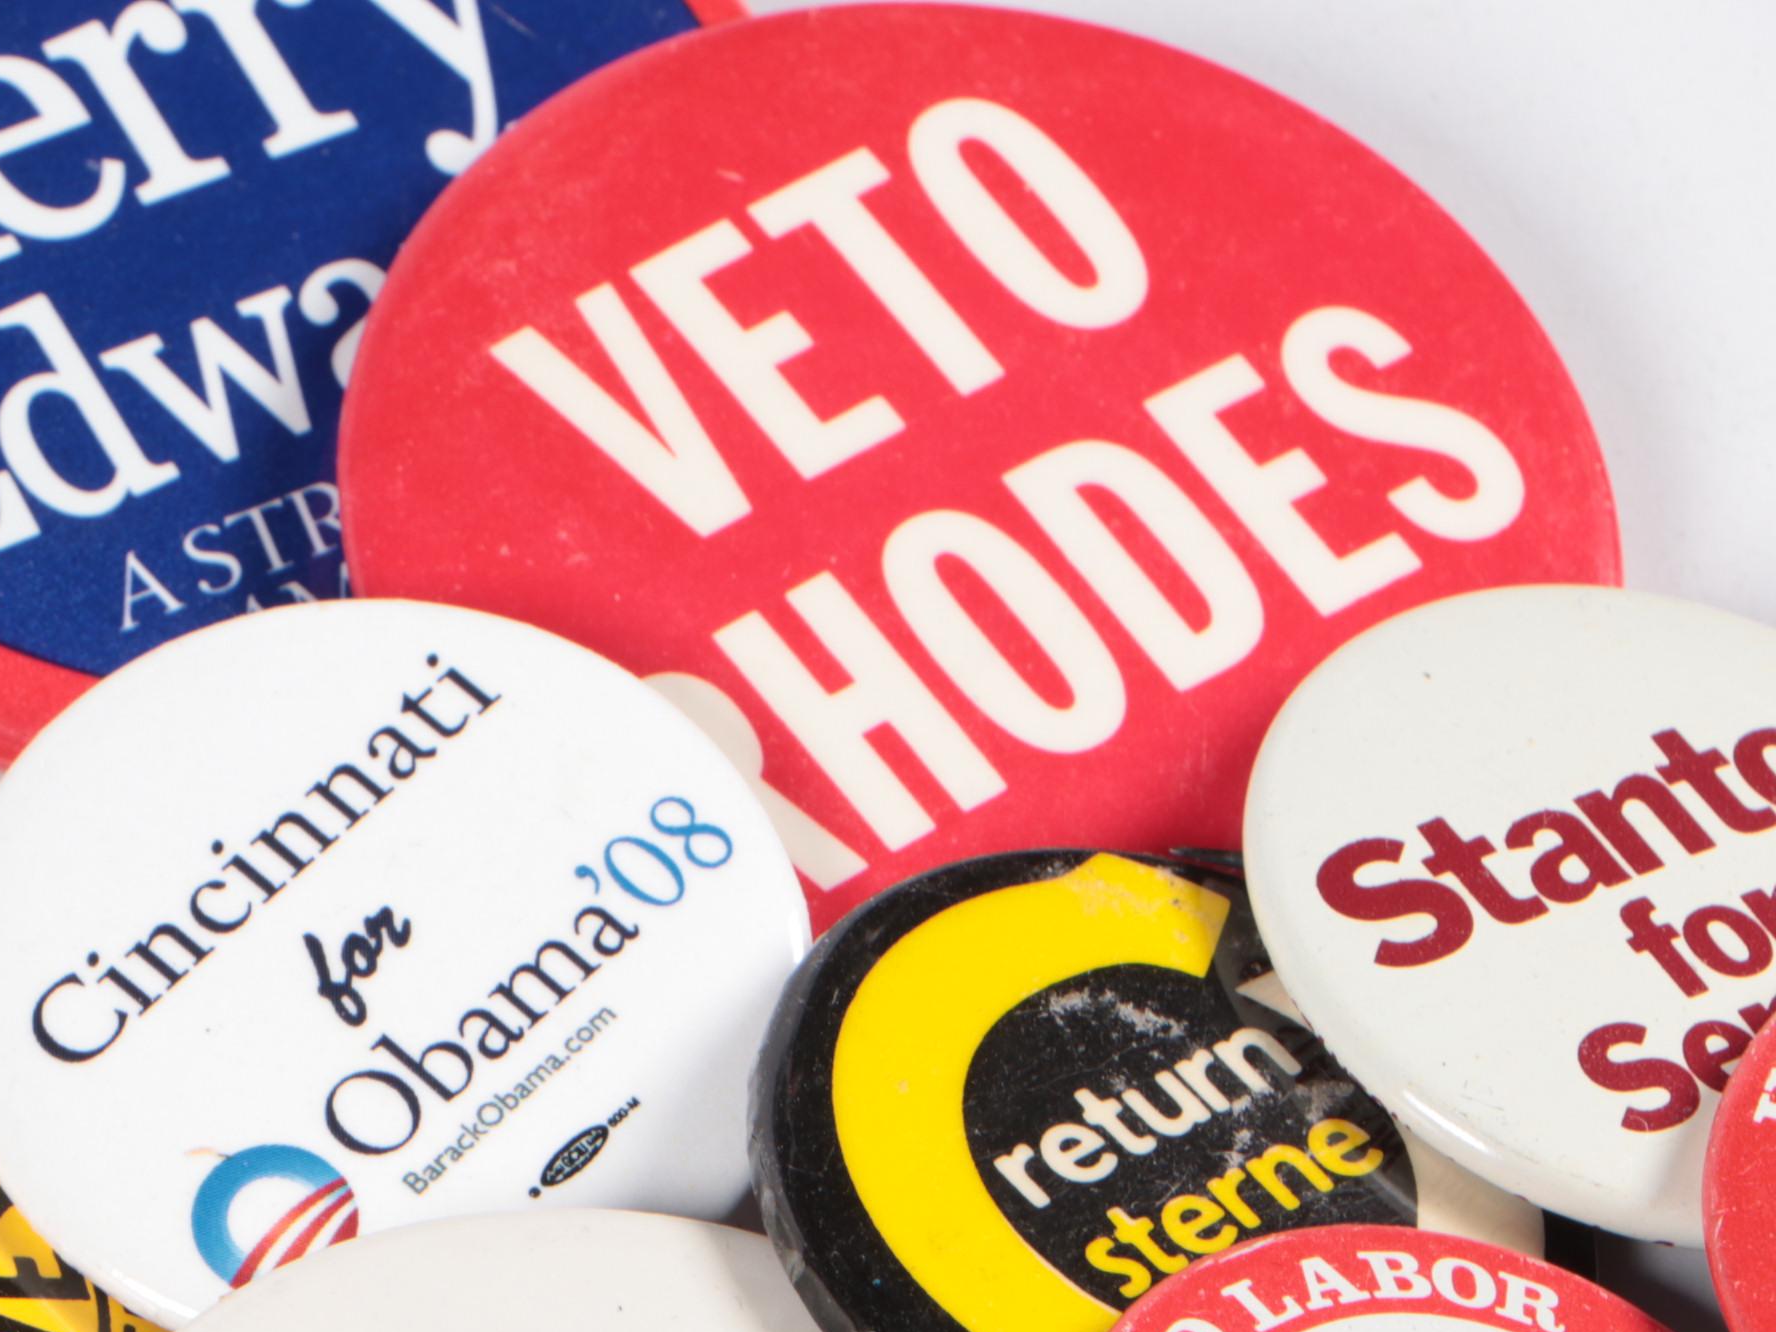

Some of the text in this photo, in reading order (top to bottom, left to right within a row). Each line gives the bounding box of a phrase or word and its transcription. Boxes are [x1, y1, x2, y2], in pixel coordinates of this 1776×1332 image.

[488, 97, 1150, 539] VETO
[120, 550, 187, 632] A
[31, 653, 502, 1064] Cincinnati
[303, 905, 412, 1027] for
[402, 1004, 619, 1197] BarackObama.com
[993, 1025, 1303, 1211] return
[1577, 993, 1776, 1133] Se
[1083, 1116, 1385, 1299] sterne
